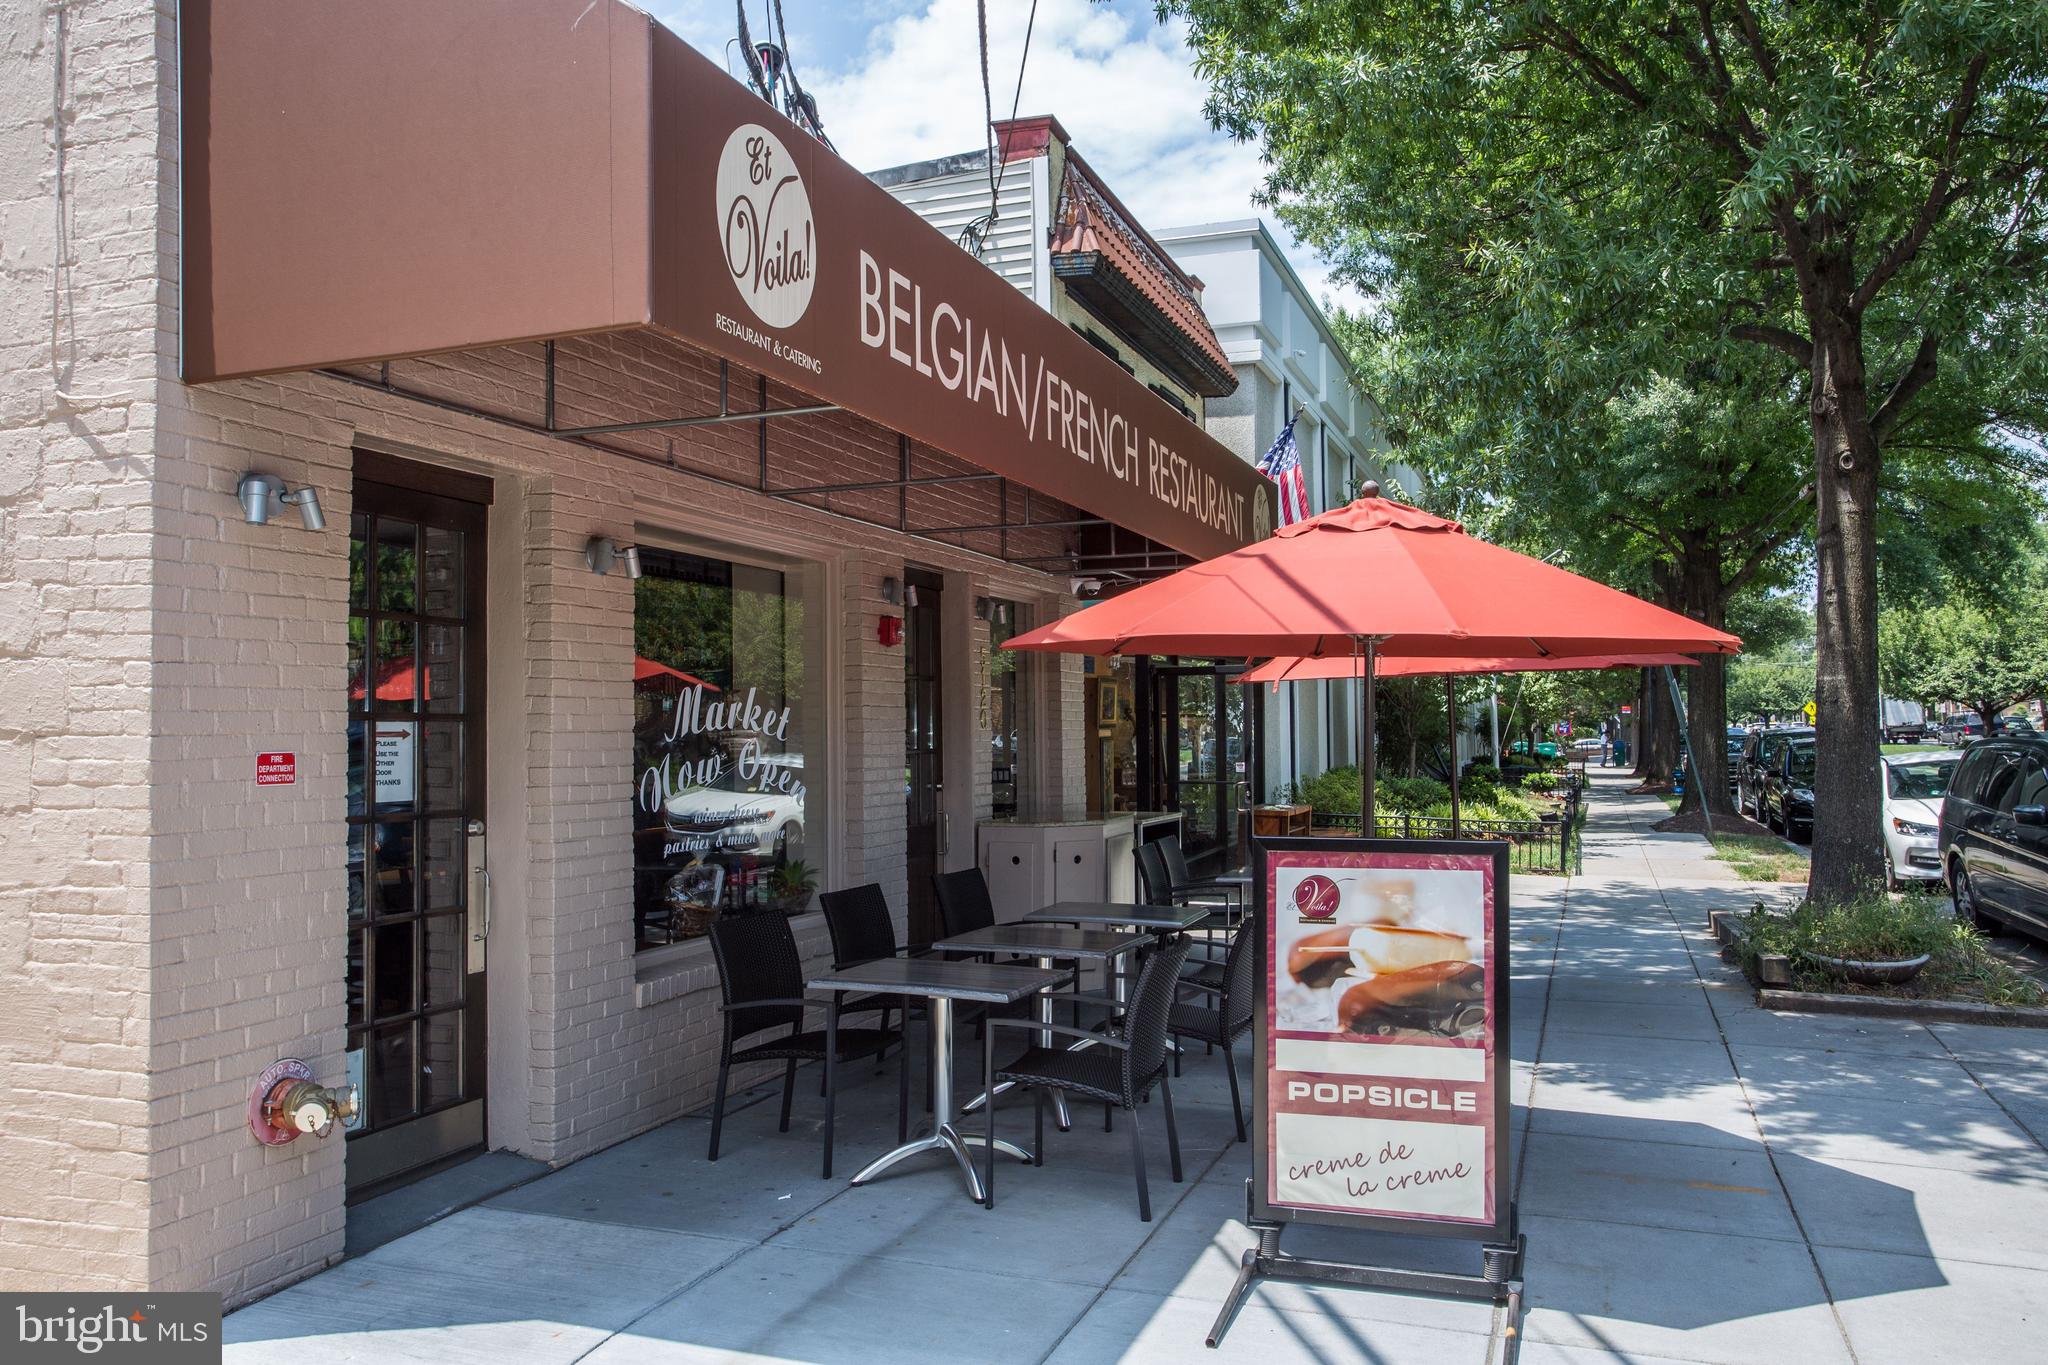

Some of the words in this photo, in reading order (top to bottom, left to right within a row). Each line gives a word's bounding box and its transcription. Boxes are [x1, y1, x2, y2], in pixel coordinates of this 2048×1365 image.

[746, 136, 772, 185] Et
[725, 175, 811, 294] Voila!
[715, 312, 772, 352] RESTAURANT
[773, 340, 782, 357] &
[783, 345, 822, 375] CATERING
[860, 248, 1139, 487] BELGIAN/FRENCH
[1148, 437, 1245, 542] RESTAURANT
[664, 683, 791, 742] Market
[258, 764, 294, 773] DEPARTMENT
[270, 755, 284, 763] FIRE
[640, 752, 723, 813] Now
[738, 737, 807, 807] Open
[258, 774, 294, 782] CONNECTION
[693, 807, 727, 825] wine,
[729, 804, 760, 819] cheese
[664, 837, 711, 858] pastries
[715, 835, 723, 848] &
[727, 828, 756, 846] much
[760, 829, 786, 841] more
[1288, 1081, 1477, 1112] POPSICLE
[1289, 1152, 1371, 1181] creme
[1379, 1141, 1414, 1165] de
[1347, 1177, 1378, 1197] la
[1386, 1162, 1472, 1191] creme
